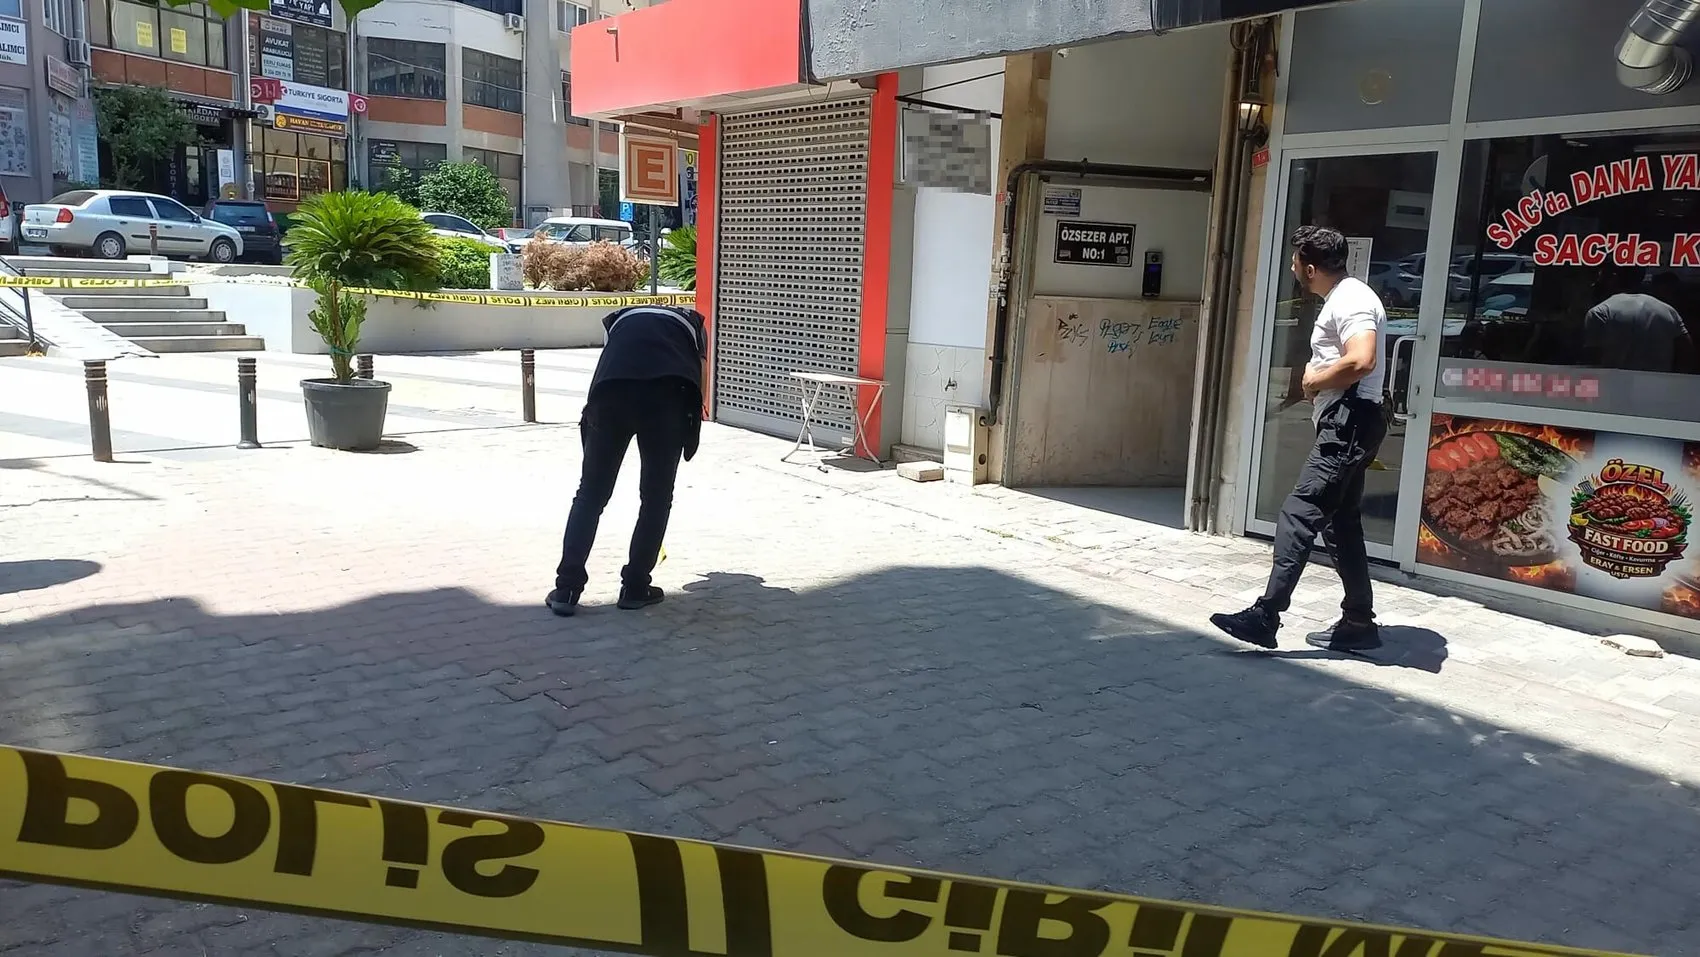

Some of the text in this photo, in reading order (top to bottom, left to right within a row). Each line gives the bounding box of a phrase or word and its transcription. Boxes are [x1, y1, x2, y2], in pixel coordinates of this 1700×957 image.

[264, 36, 290, 48] AVUKAT
[637, 149, 666, 190] E
[1570, 156, 1654, 206] DANA
[1660, 154, 1700, 191] YA
[1061, 226, 1130, 245] ÖZSEZER APT.
[1082, 247, 1106, 260] NO:1
[1600, 458, 1669, 492] ÖZEL
[1584, 528, 1669, 553] FAST FOOD
[1590, 556, 1614, 570] ERAY
[1622, 565, 1654, 574] ERSEN
[1611, 570, 1629, 578] USTA
